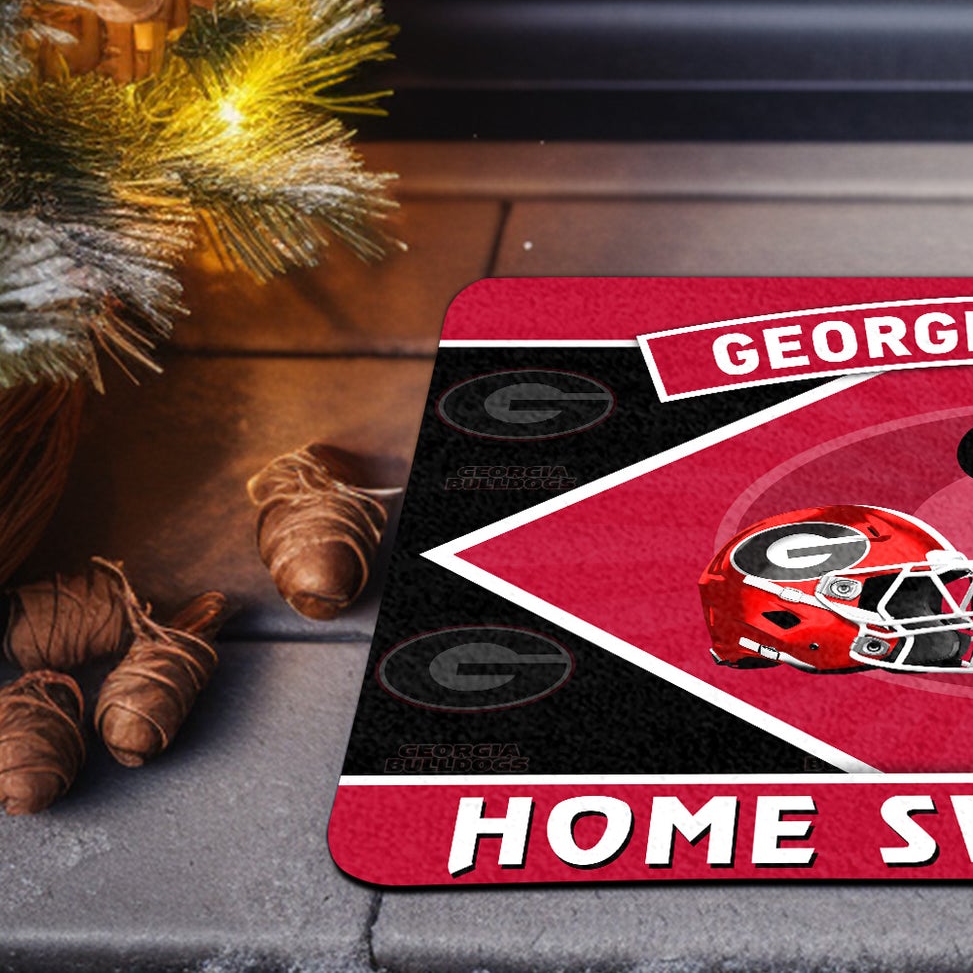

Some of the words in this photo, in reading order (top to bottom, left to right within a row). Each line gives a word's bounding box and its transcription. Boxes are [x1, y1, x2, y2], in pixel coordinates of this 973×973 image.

[457, 466, 568, 478] GEORGIA
[445, 477, 577, 490] BULLDOGS
[766, 533, 868, 568] G
[399, 744, 520, 758] GEORGIA
[384, 757, 529, 773] BULLDOGS
[448, 794, 817, 877] HOME
